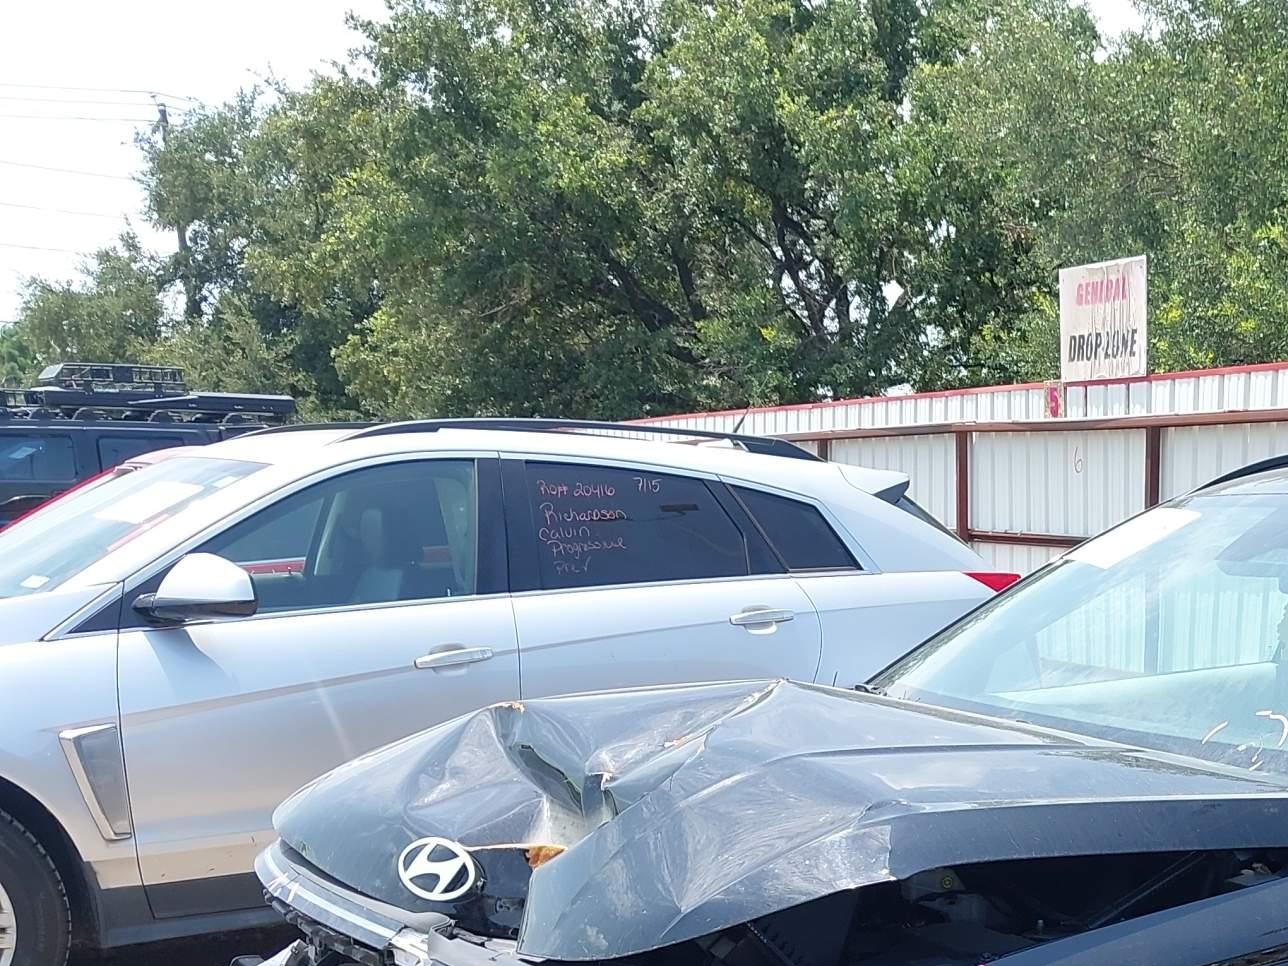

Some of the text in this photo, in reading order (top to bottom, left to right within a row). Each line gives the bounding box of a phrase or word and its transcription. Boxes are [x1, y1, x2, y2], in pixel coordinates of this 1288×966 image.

[1068, 330, 1102, 362] DROP
[1074, 447, 1083, 473] 6
[573, 482, 616, 499] 20416
